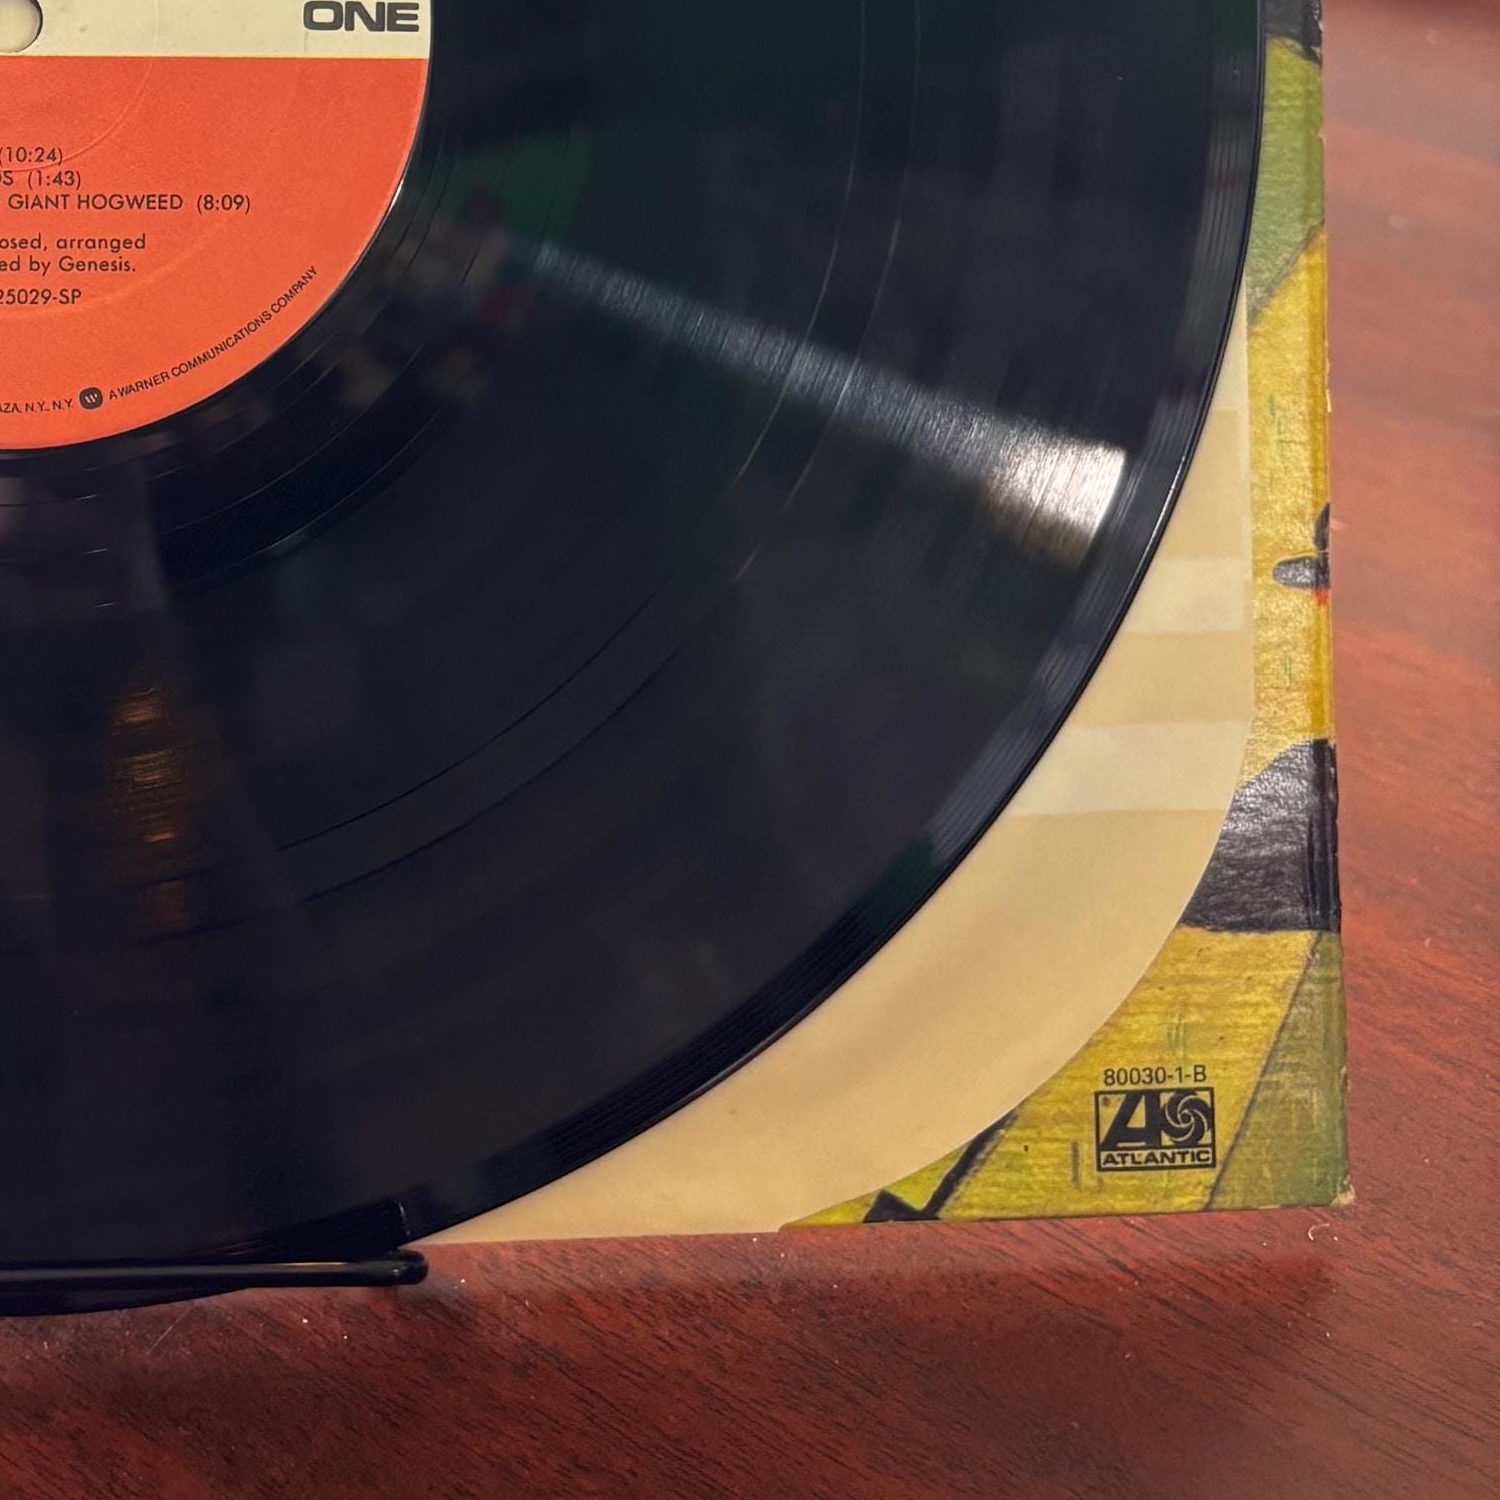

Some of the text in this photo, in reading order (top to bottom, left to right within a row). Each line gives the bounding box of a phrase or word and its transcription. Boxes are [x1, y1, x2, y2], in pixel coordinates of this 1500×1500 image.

[28, 170, 81, 189] (1:43)
[8, 193, 70, 210] GIANT
[78, 193, 183, 210] HOGWEED
[197, 193, 250, 214] (8:09)
[56, 232, 145, 253] arranged
[30, 255, 50, 276] by
[59, 255, 135, 272] Genesis.
[109, 390, 118, 400] A
[118, 371, 170, 397] WARNER
[171, 311, 272, 377] COMMUNICATIONS
[270, 265, 317, 313] COMPANY
[1103, 1065, 1206, 1085] 80030-1-B
[1103, 1151, 1210, 1165] ATLANTIC
